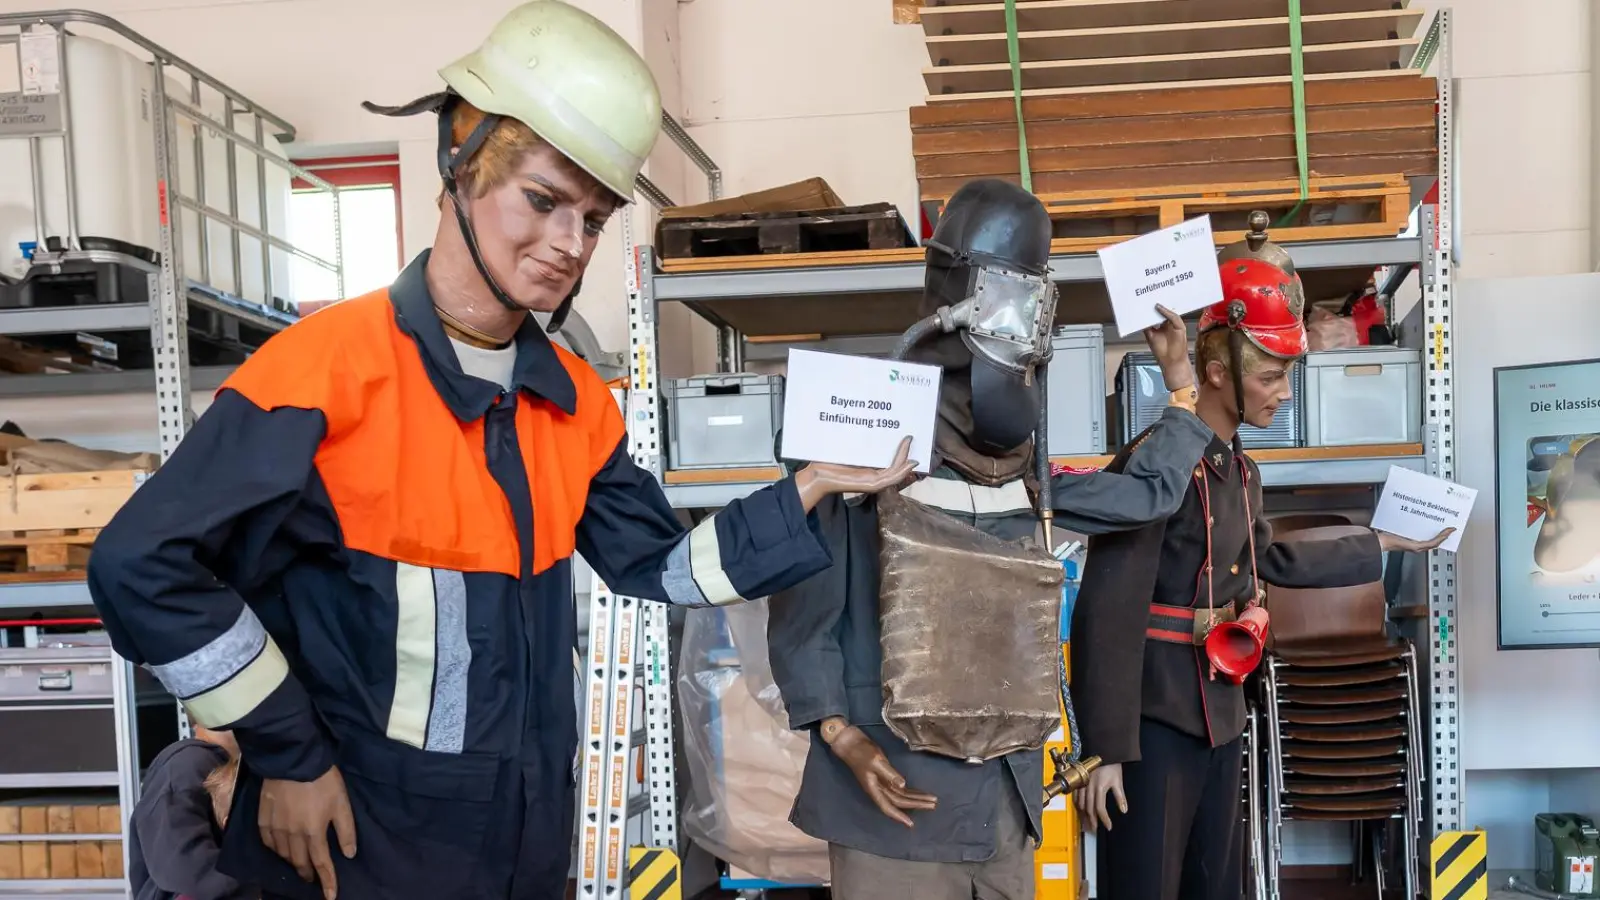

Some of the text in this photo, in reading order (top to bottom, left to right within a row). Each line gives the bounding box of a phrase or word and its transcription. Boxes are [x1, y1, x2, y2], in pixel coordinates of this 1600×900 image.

[1144, 259, 1177, 277] Bayern 2
[1135, 271, 1194, 297] Einführung 1950
[830, 395, 892, 411] Bayern 2000
[1530, 400, 1552, 412] Die
[819, 411, 900, 429] Einführung 1999
[1392, 491, 1460, 518] Historische Bekleidung
[1409, 508, 1445, 523] Jahrhundert
[1568, 593, 1590, 601] Leder
